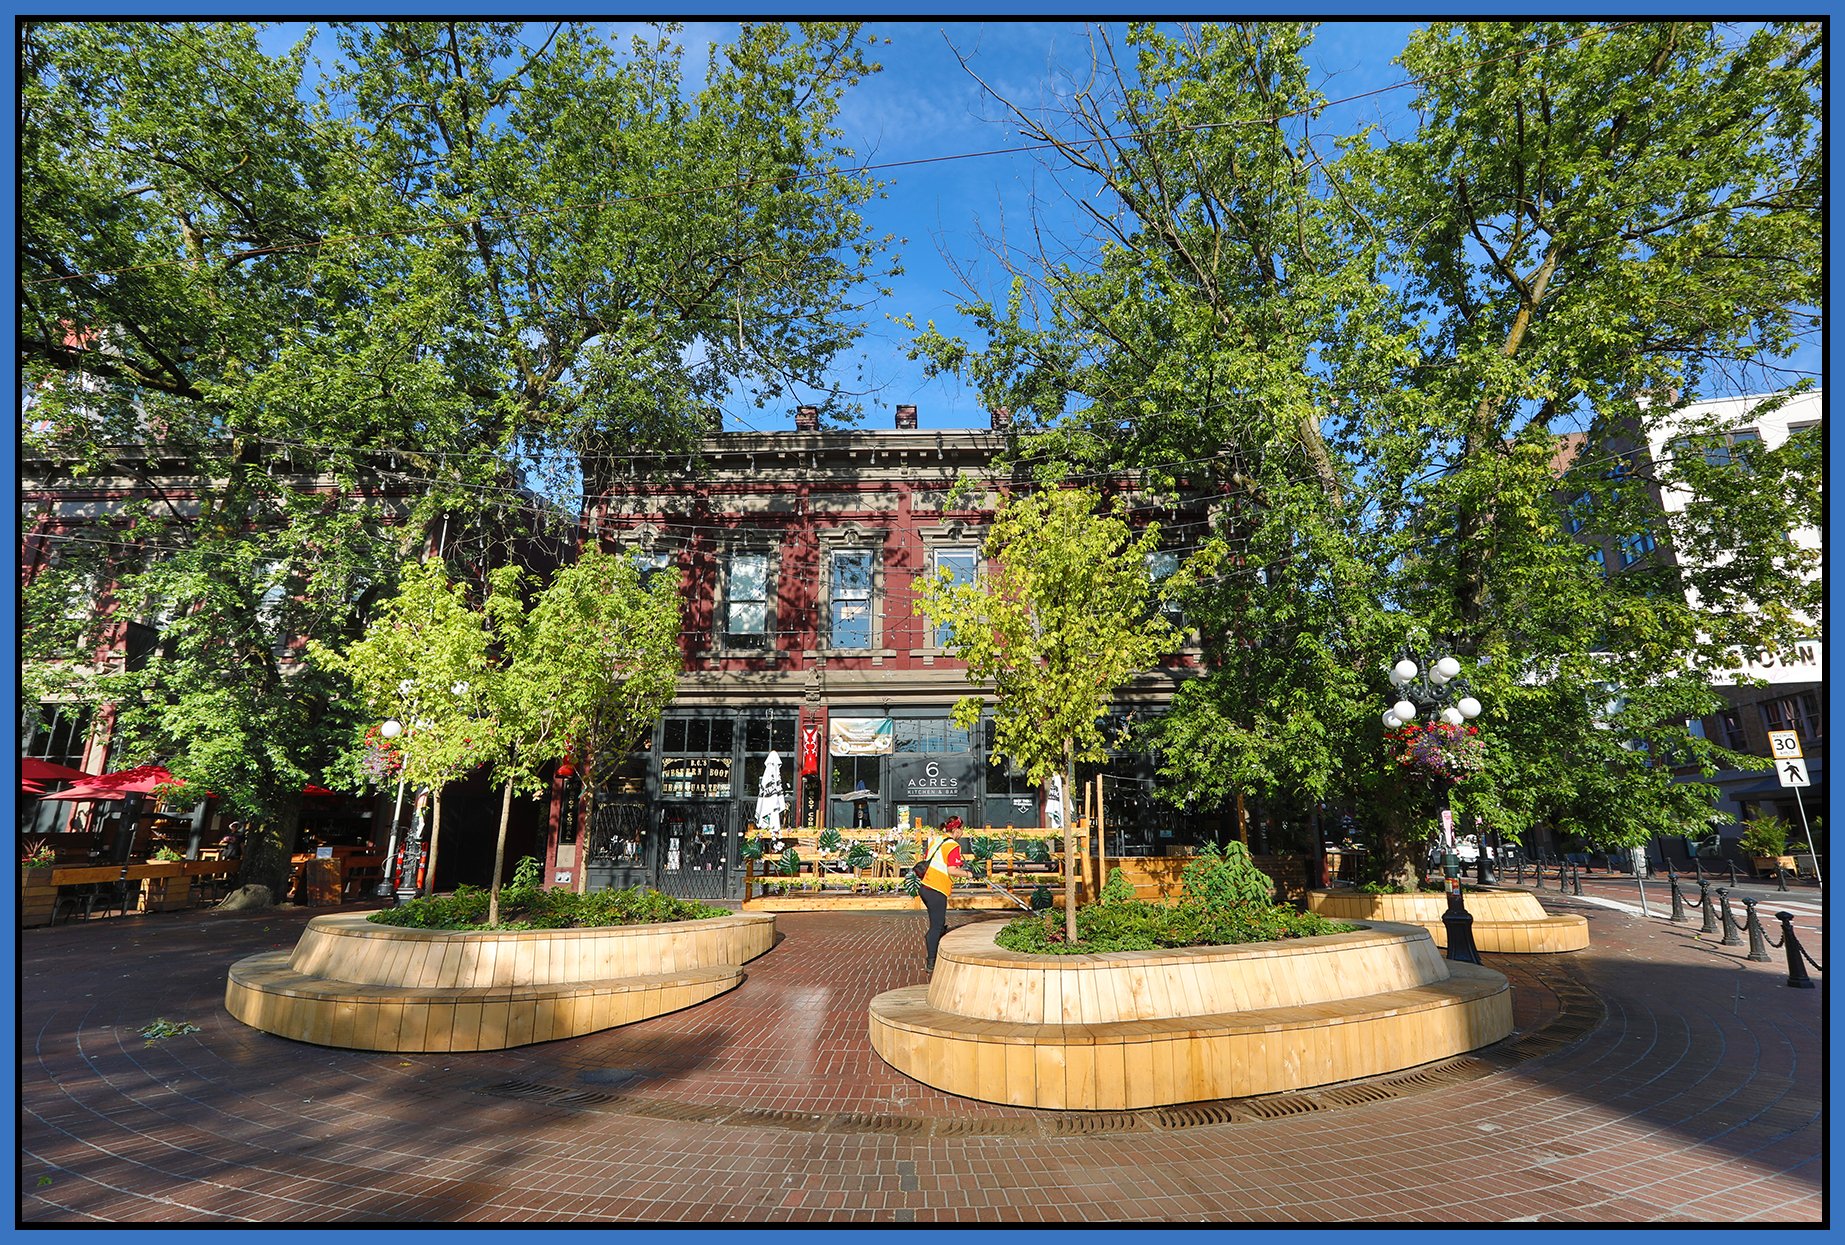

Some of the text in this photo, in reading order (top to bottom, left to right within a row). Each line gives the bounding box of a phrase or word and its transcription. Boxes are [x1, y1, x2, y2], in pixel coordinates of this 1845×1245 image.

[1774, 738, 1796, 751] 30
[663, 767, 729, 778] WESTERN BOOT
[925, 761, 939, 778] 6
[907, 778, 958, 787] ACRES
